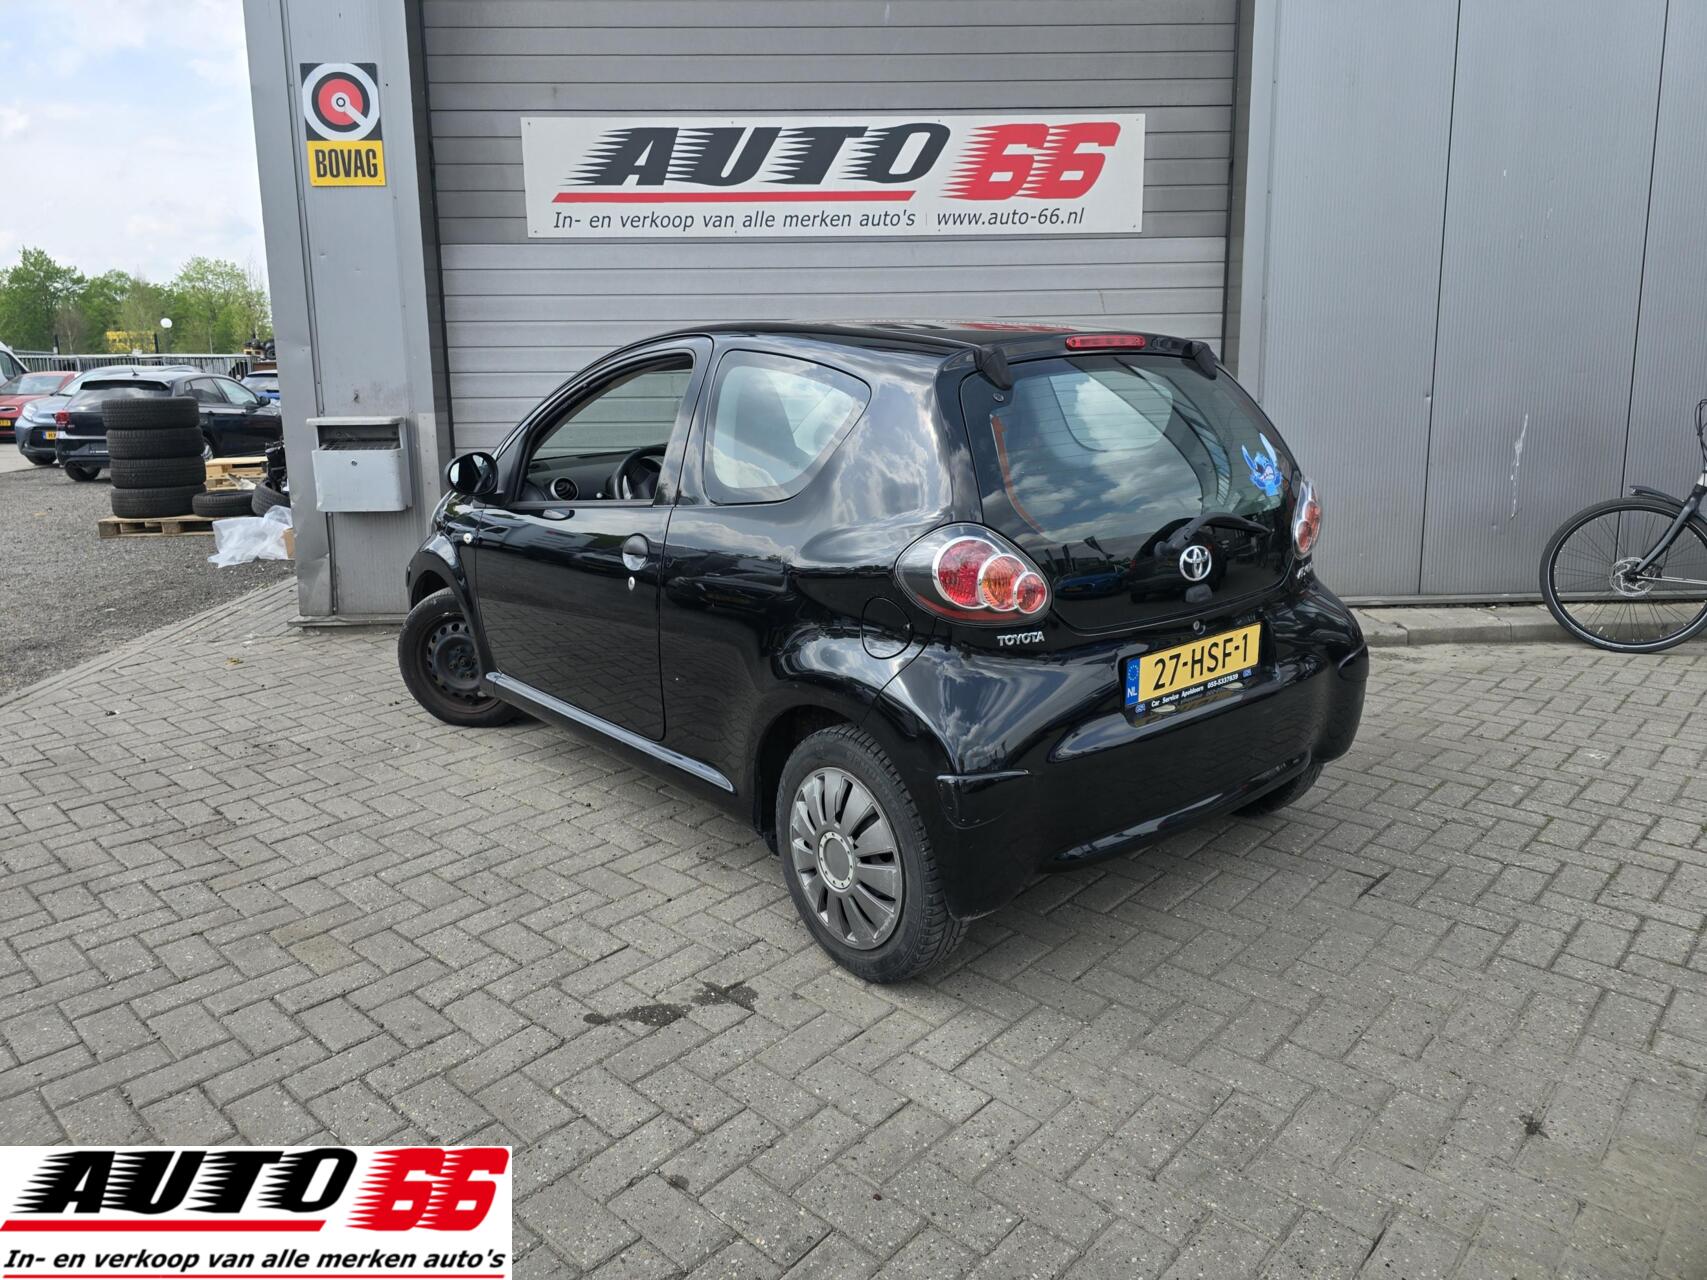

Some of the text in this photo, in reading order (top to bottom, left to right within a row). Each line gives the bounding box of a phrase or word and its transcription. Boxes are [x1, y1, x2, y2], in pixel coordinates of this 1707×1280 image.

[314, 148, 379, 178] BOVAG
[559, 122, 1121, 201] AUTO 66
[553, 207, 1085, 232] In- en verkoop van alle merken auto's www.auto-66.nl
[997, 631, 1045, 647] TOYOTA
[1153, 633, 1249, 691] 27-HSF-1
[1127, 686, 1138, 698] NL
